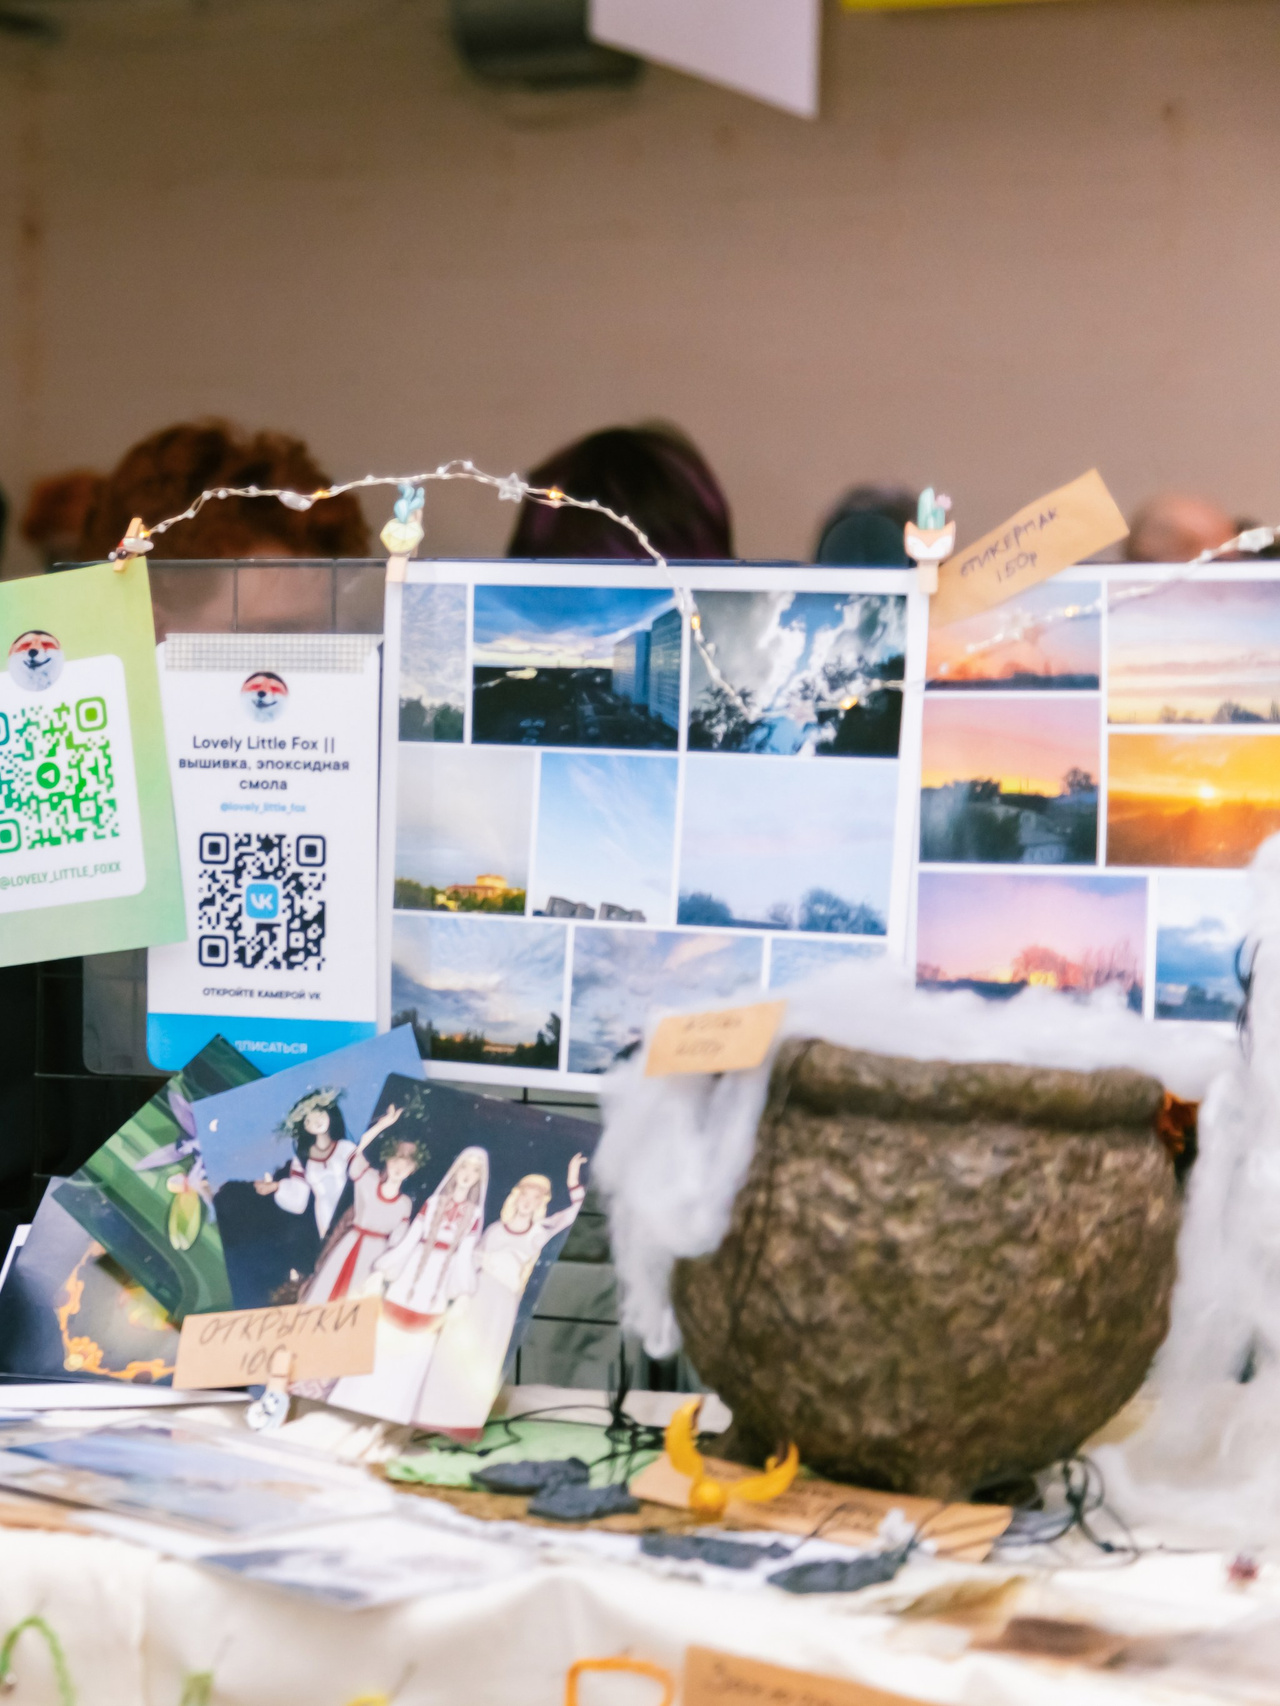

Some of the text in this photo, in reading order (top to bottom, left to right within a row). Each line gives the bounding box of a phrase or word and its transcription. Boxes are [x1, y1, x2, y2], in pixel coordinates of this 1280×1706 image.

[192, 735, 243, 753] Lovely
[247, 736, 287, 750] Little
[292, 737, 319, 750] Fox
[178, 758, 351, 773] вышивка, эпоксидная
[239, 778, 288, 791] смола
[202, 986, 255, 999] ОТКРОЙТЕ
[257, 988, 306, 1001] КАМЕРОЙ
[199, 1304, 361, 1346] ОТКРЫТКИ
